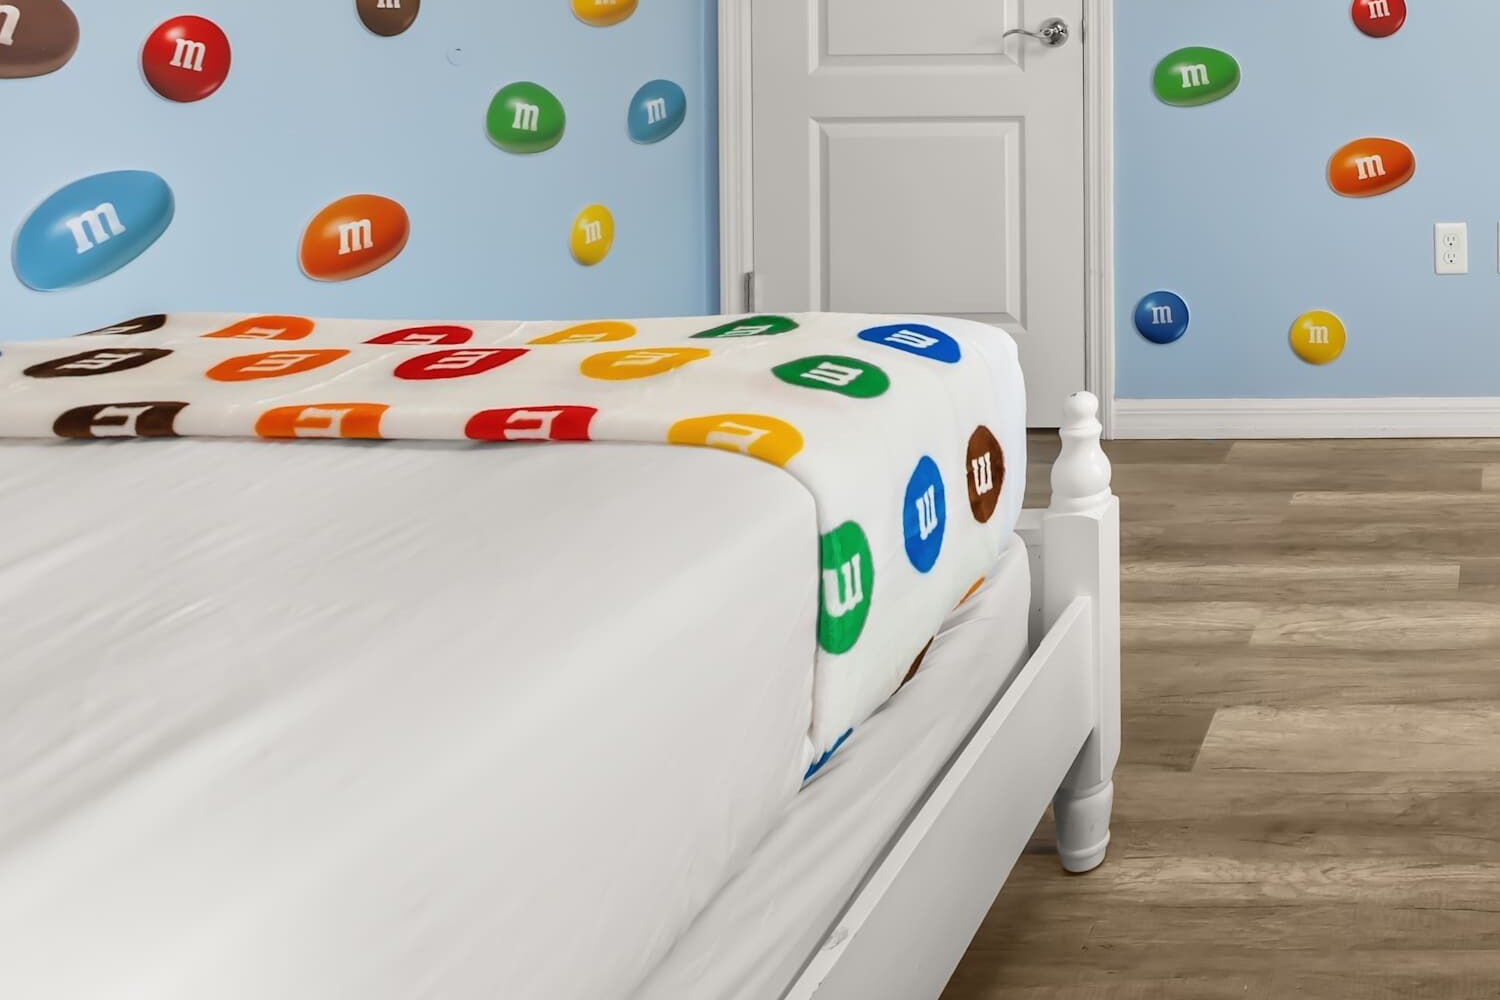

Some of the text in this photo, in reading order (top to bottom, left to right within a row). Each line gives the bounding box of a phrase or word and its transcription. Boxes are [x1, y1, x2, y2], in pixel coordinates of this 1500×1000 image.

[170, 38, 206, 72] m
[1180, 63, 1210, 88] m
[512, 102, 539, 131] m
[646, 97, 668, 123] m
[1355, 154, 1386, 181] m
[66, 201, 126, 253] m
[338, 218, 374, 255] m
[584, 219, 602, 244] m
[1151, 304, 1173, 325] m
[1308, 326, 1329, 345] m
